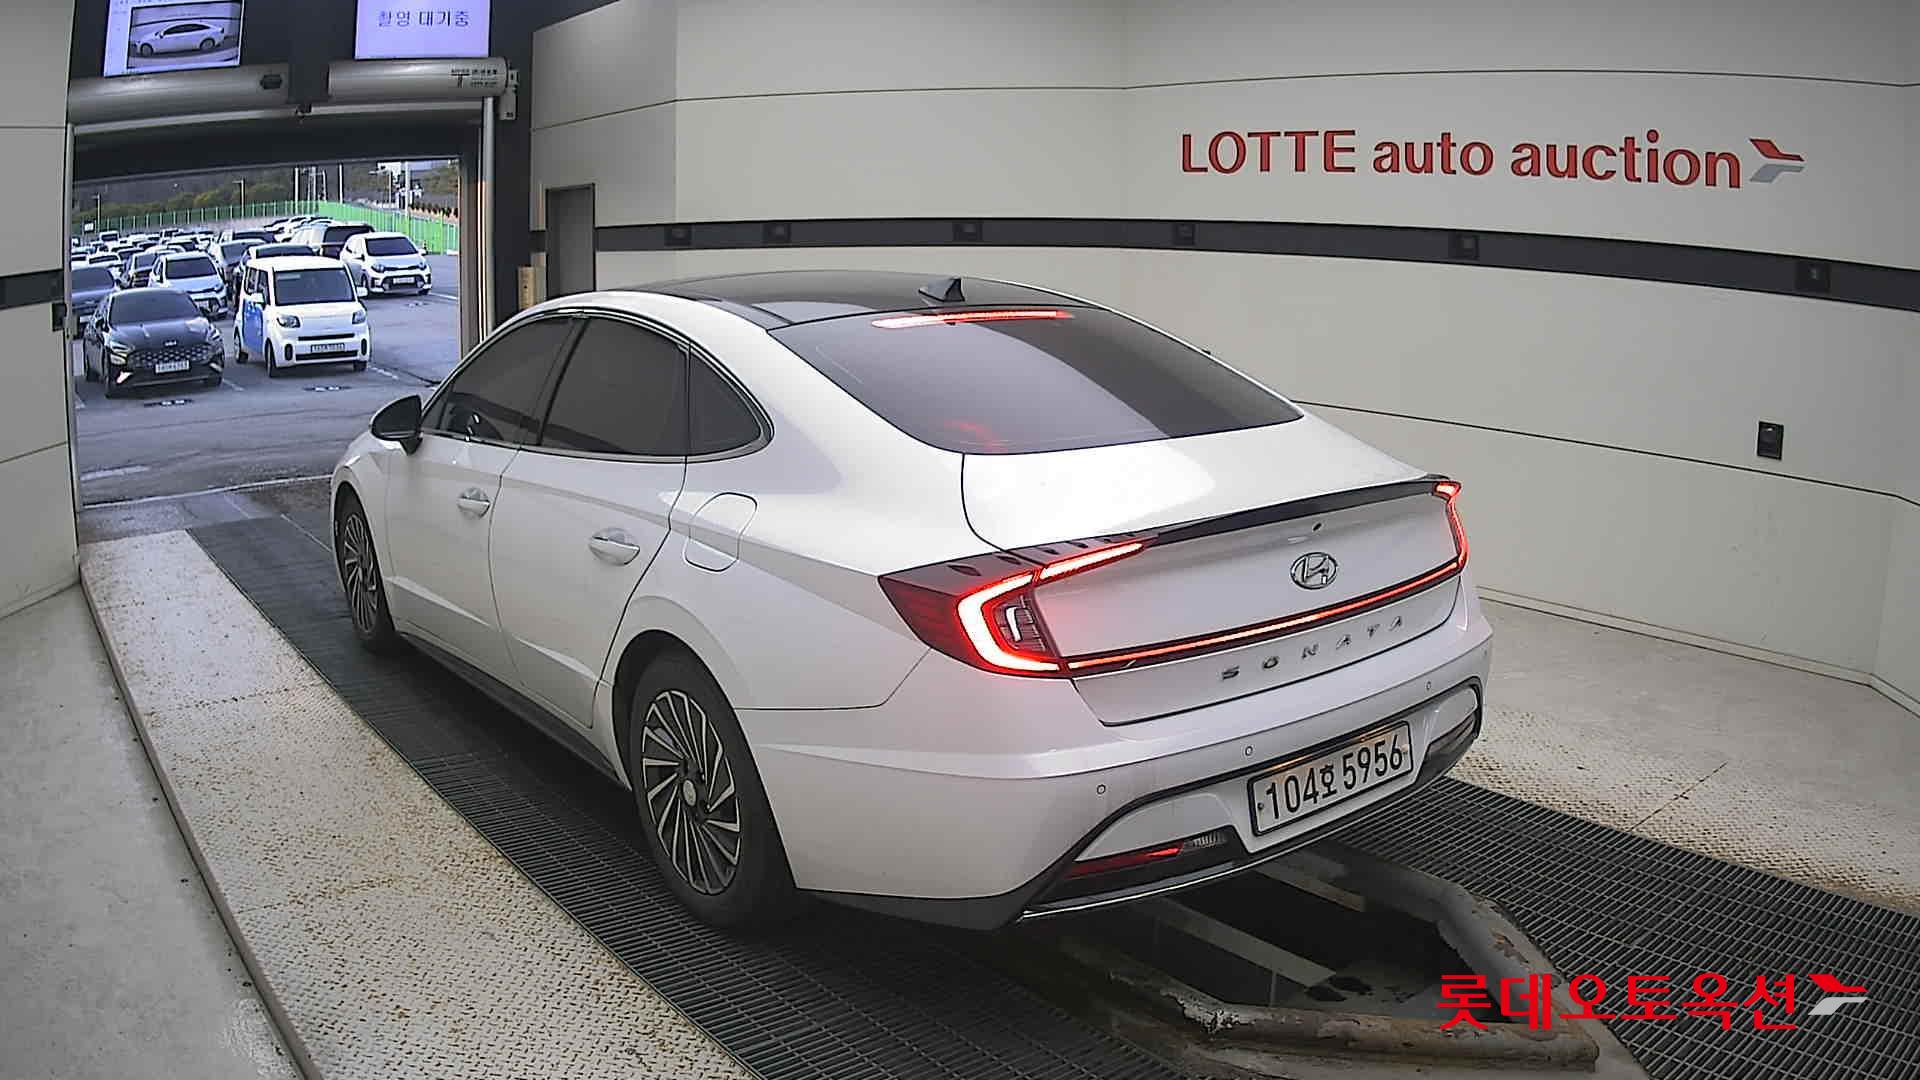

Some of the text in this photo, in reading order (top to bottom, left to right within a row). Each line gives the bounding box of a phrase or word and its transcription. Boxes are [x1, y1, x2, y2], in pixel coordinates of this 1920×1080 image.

[1181, 129, 1742, 188] LOTTE auto auction
[1221, 616, 1402, 681] SONATA
